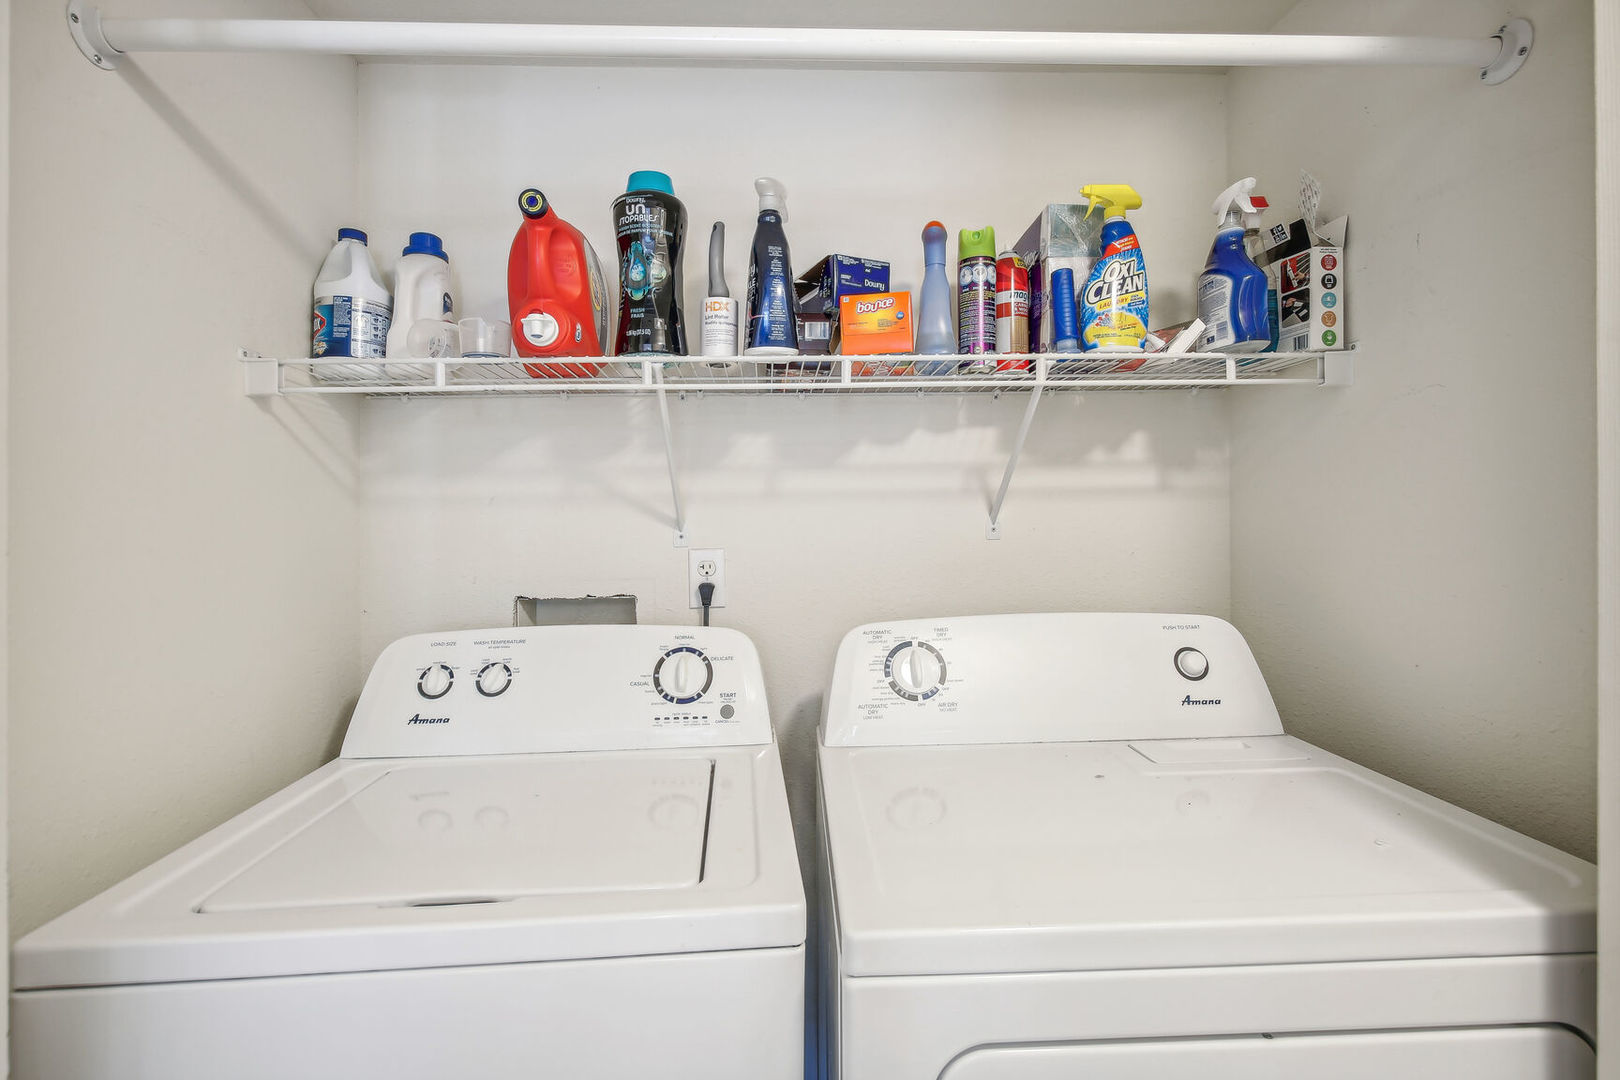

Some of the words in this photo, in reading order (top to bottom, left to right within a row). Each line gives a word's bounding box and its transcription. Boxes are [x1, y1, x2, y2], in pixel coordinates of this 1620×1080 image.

[1103, 260, 1136, 282] OXI
[864, 279, 884, 291] Downy
[1086, 273, 1144, 304] CLEAN
[706, 301, 730, 312] HDX
[856, 298, 894, 313] bounce
[1099, 297, 1128, 310] LAUDRY
[1182, 694, 1221, 706] Amana
[408, 714, 450, 725] Amana
